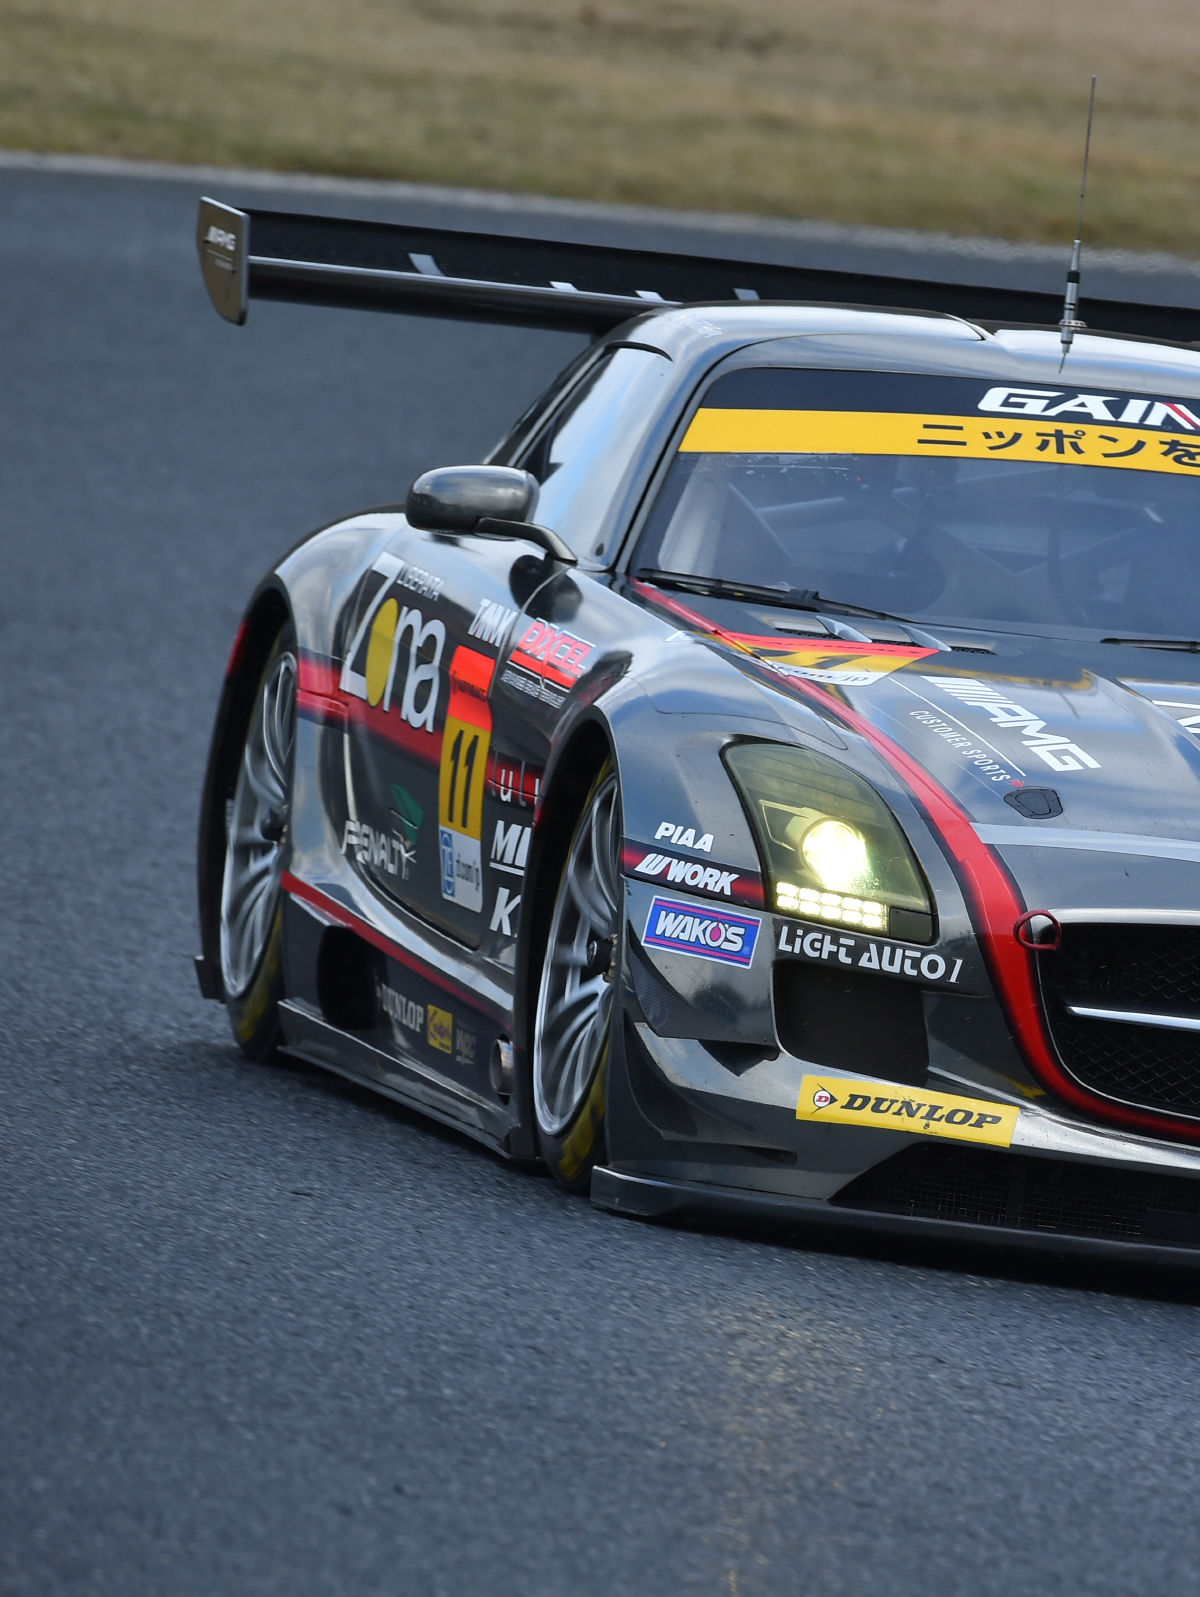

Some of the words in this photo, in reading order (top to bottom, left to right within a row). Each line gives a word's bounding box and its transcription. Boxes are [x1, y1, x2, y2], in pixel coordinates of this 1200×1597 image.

[517, 617, 596, 677] DIXCEL
[909, 710, 972, 748] CUSTOMER
[962, 749, 1011, 782] SPORTS
[448, 729, 479, 829] 11
[654, 821, 715, 853] PIAA
[666, 858, 740, 896] WORK
[655, 909, 747, 953] WAKO'S
[381, 984, 424, 1033] DUNLOP
[840, 1093, 1003, 1130] DUNLOP
